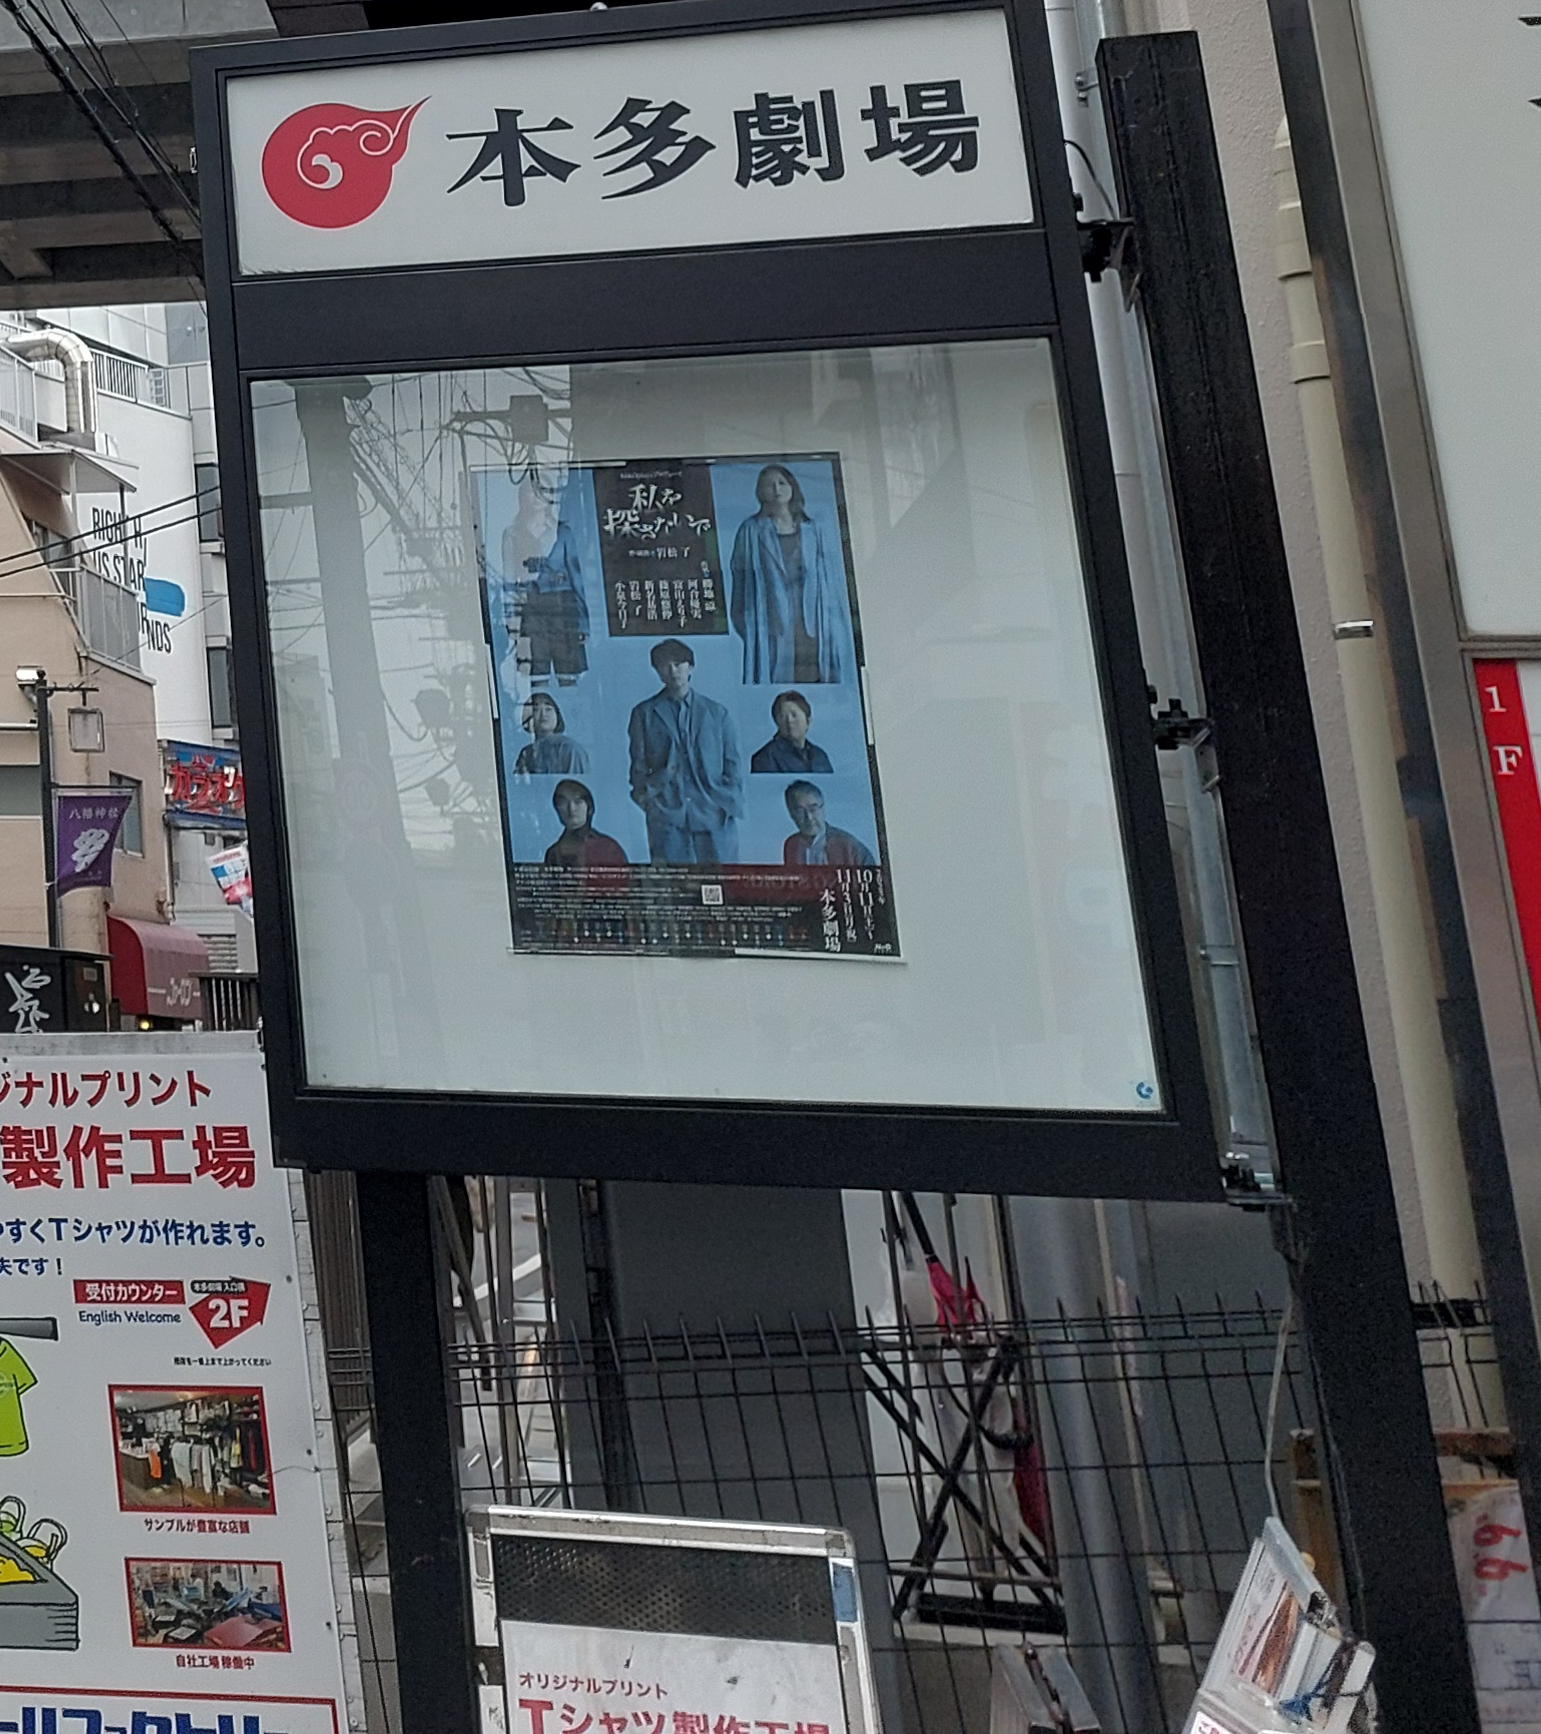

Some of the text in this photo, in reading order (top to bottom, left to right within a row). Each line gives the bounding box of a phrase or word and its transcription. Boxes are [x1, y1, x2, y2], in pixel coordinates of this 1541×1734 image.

[445, 79, 981, 208] 本多劇場
[819, 888, 841, 953] 本多劇場
[85, 1282, 178, 1302] 受付カウンター
[78, 1310, 182, 1327] English Welcome
[207, 1298, 249, 1329] 2F
[143, 1518, 252, 1535] サンプルが豊富な店舗
[518, 1671, 668, 1701] オリジナルプリント
